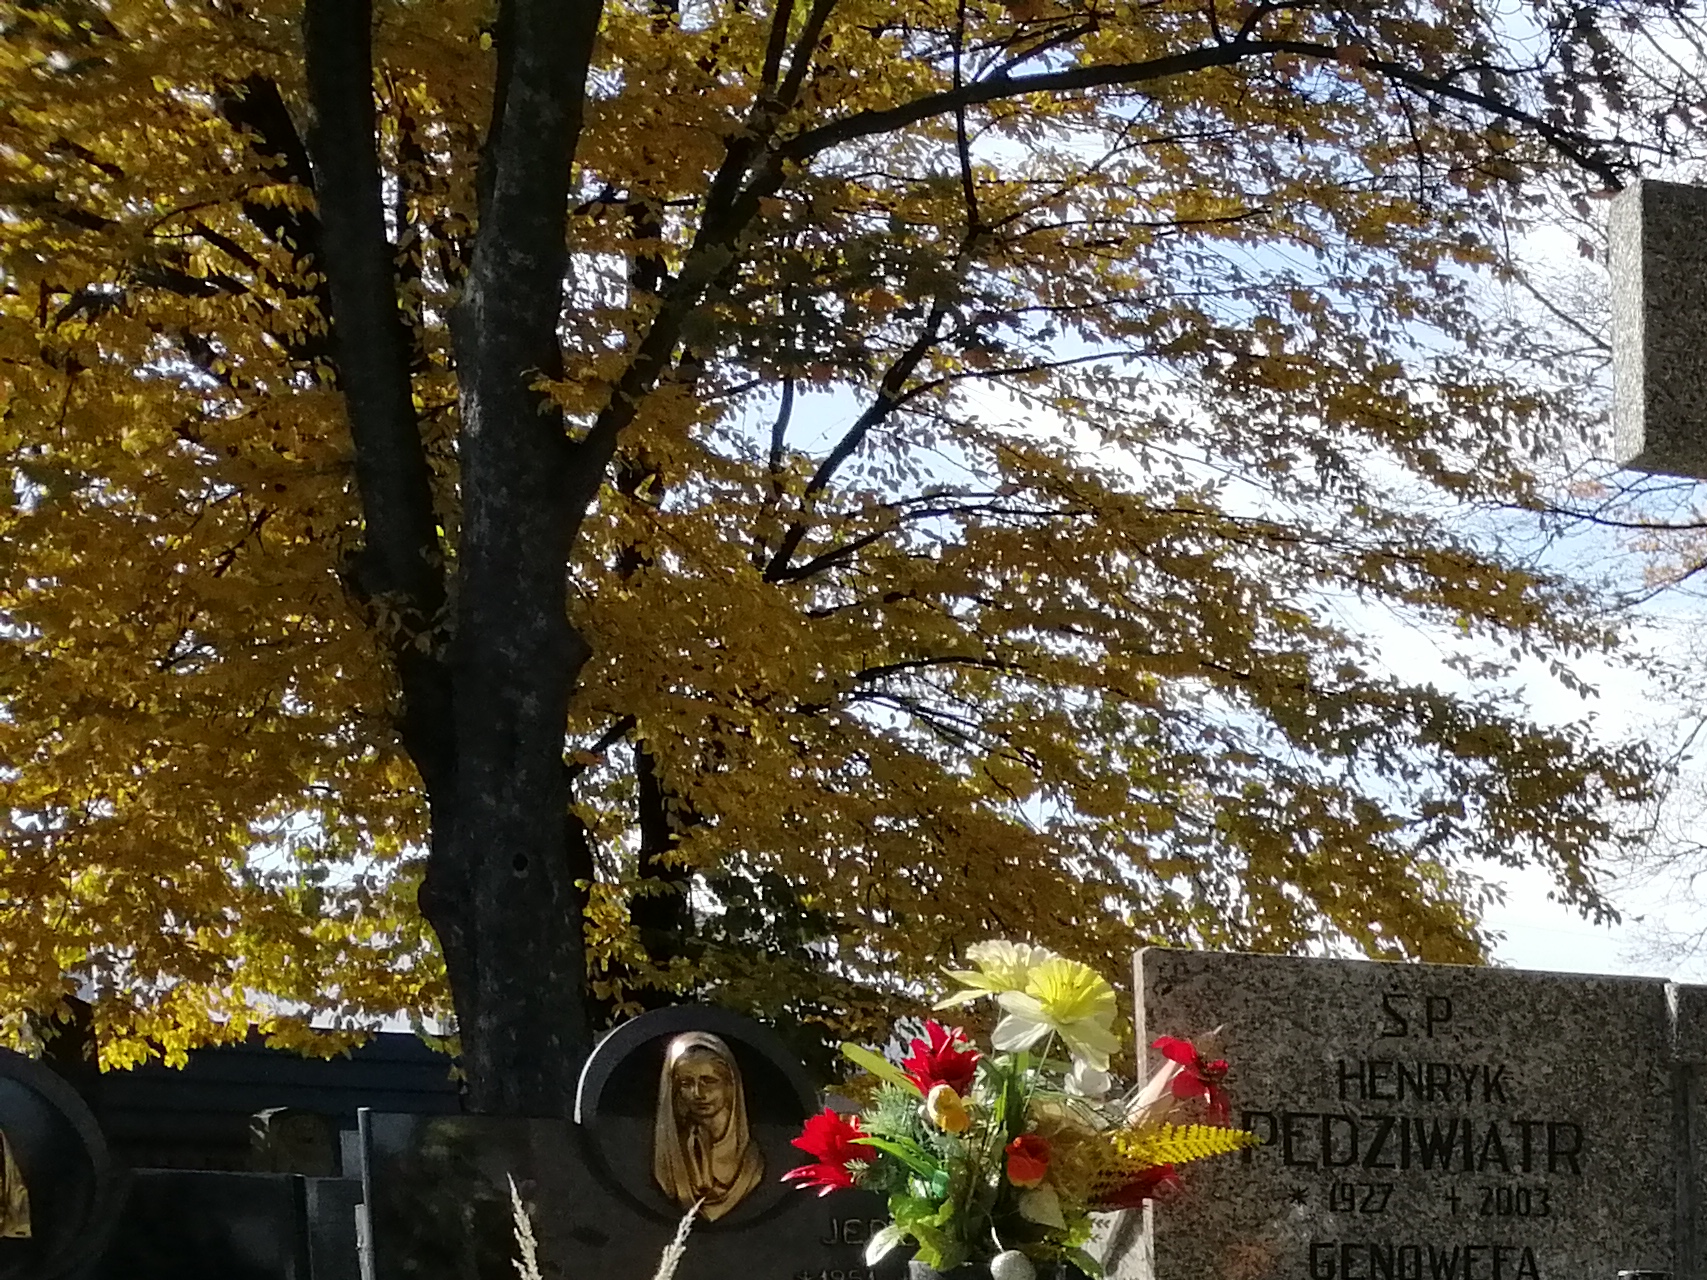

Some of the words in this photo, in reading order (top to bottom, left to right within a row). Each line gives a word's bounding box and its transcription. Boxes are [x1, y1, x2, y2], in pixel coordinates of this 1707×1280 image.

[1337, 1060, 1507, 1104] HENRYK
[1330, 1183, 1394, 1213] 1927
[1479, 1186, 1551, 1218] 2003
